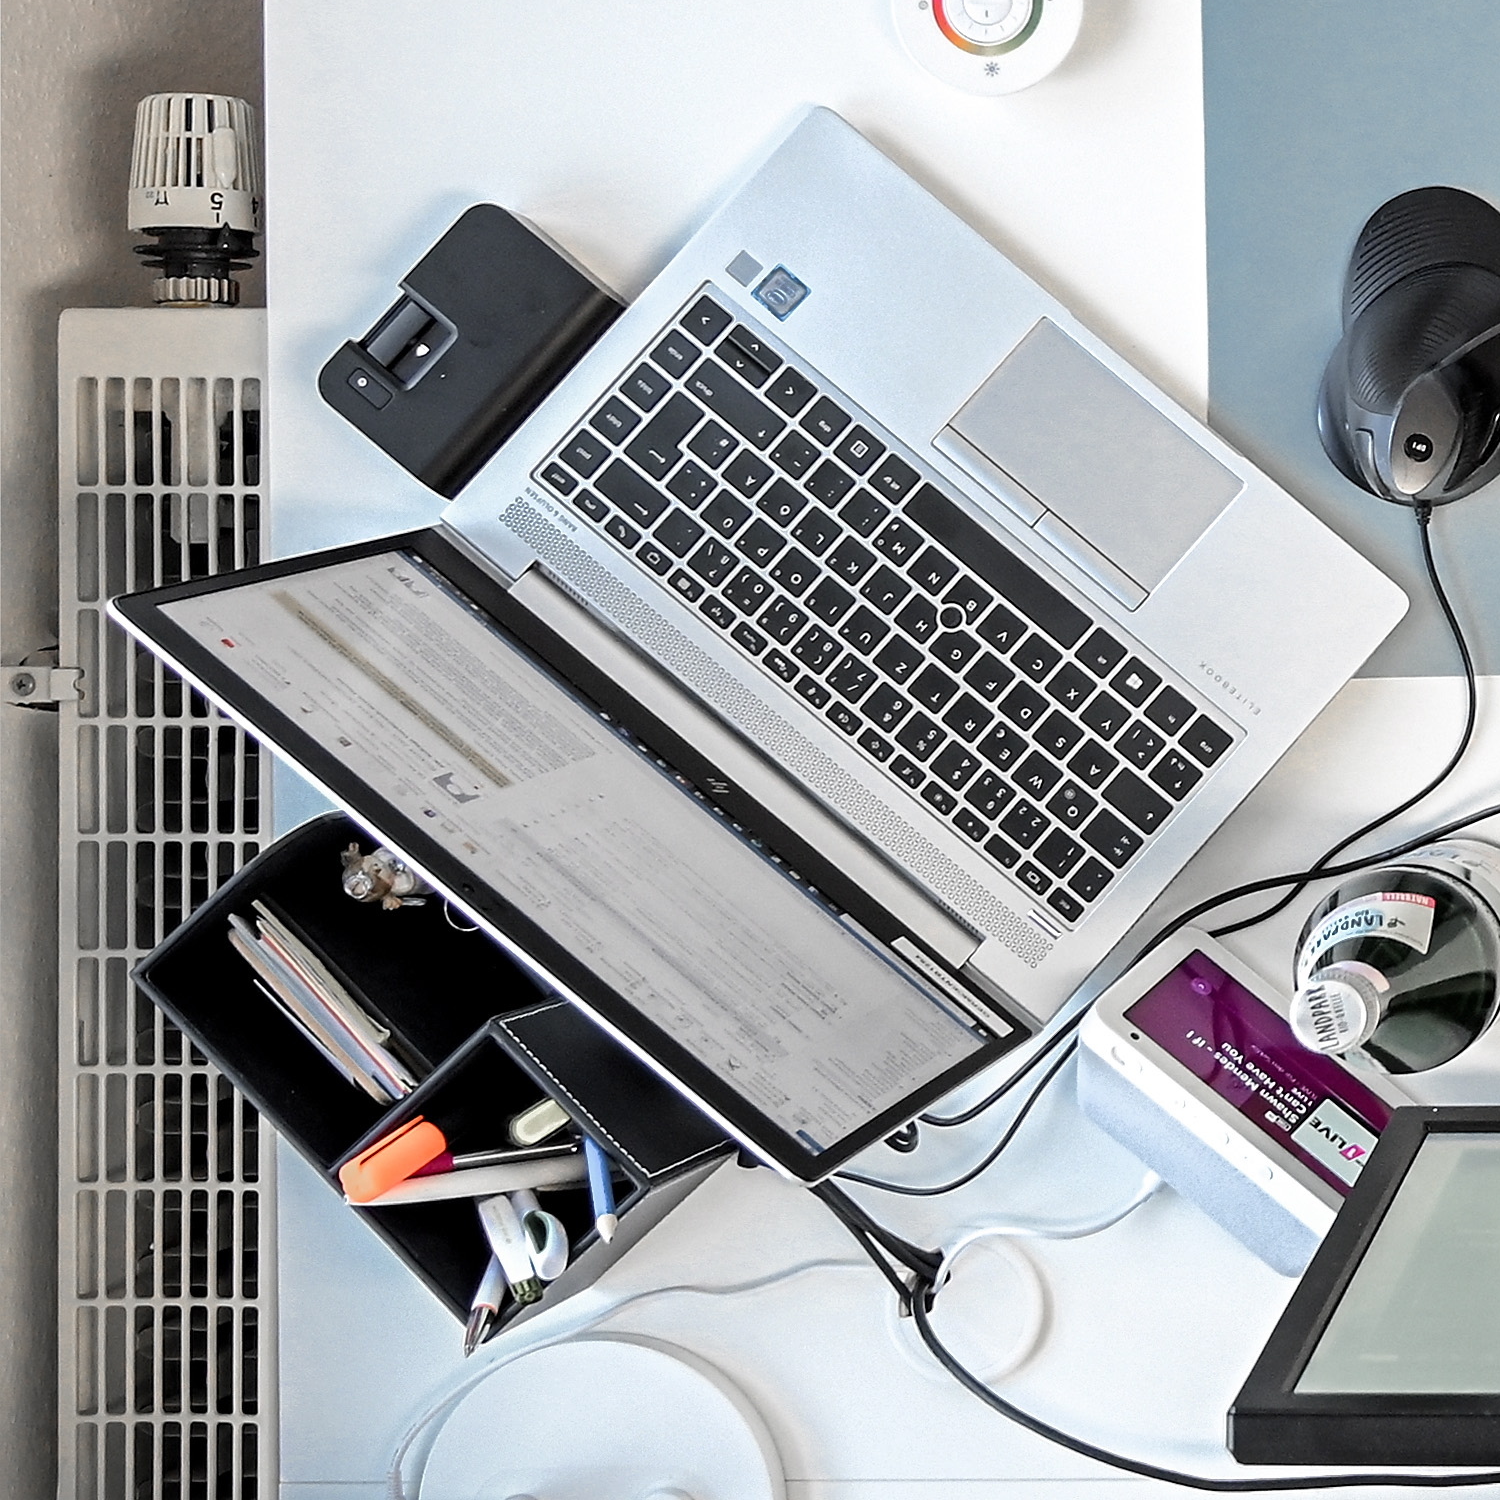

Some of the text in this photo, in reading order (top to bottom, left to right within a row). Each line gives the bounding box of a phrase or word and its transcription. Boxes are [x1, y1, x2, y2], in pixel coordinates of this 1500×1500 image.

[209, 192, 223, 210] 5
[251, 196, 259, 214] 4
[892, 542, 906, 555] M
[928, 572, 940, 585] N
[966, 600, 977, 611] B
[915, 620, 928, 632] H
[859, 632, 871, 644] U
[997, 632, 1007, 642] V
[951, 649, 962, 660] G
[895, 662, 907, 674] Z
[1032, 659, 1043, 670] C
[985, 682, 997, 690] F
[1199, 661, 1261, 715] ELITEBOOK
[930, 693, 940, 702] T
[1066, 688, 1079, 700] X
[1020, 708, 1032, 719] D
[965, 719, 976, 731] R
[1101, 720, 1111, 730] Y
[1055, 737, 1066, 748] S
[999, 749, 1010, 760] E
[1090, 764, 1101, 775] A
[1029, 776, 1043, 789] W
[1067, 806, 1078, 817] Q
[1306, 985, 1339, 1050] LANDPARK
[1192, 1037, 1206, 1048] If
[1213, 1052, 1259, 1091] Mendes
[1221, 1042, 1306, 1114] Can't Have You
[1291, 1087, 1308, 1102] LIVE
[1262, 1092, 1299, 1123] Shawn
